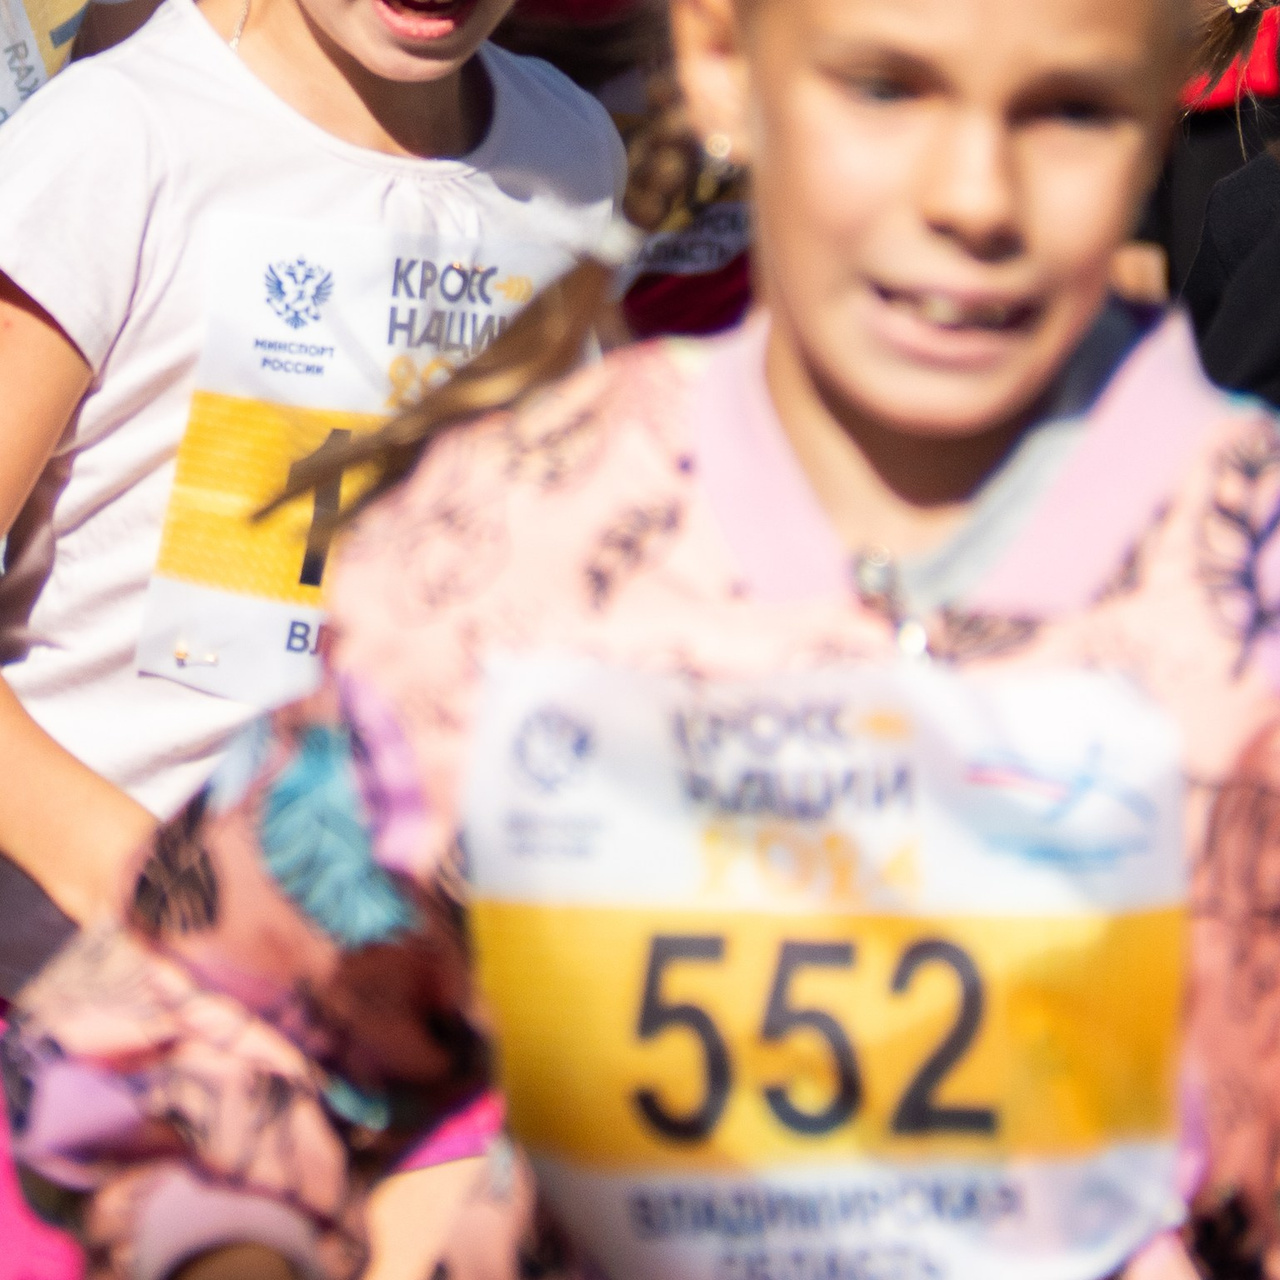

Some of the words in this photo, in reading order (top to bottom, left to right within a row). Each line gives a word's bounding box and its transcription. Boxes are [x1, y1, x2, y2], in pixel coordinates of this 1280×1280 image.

[391, 257, 500, 307] КРОСС
[253, 337, 335, 360] МИНСПОРТ
[261, 356, 326, 376] РОССИИ
[630, 930, 1000, 1144] 552
